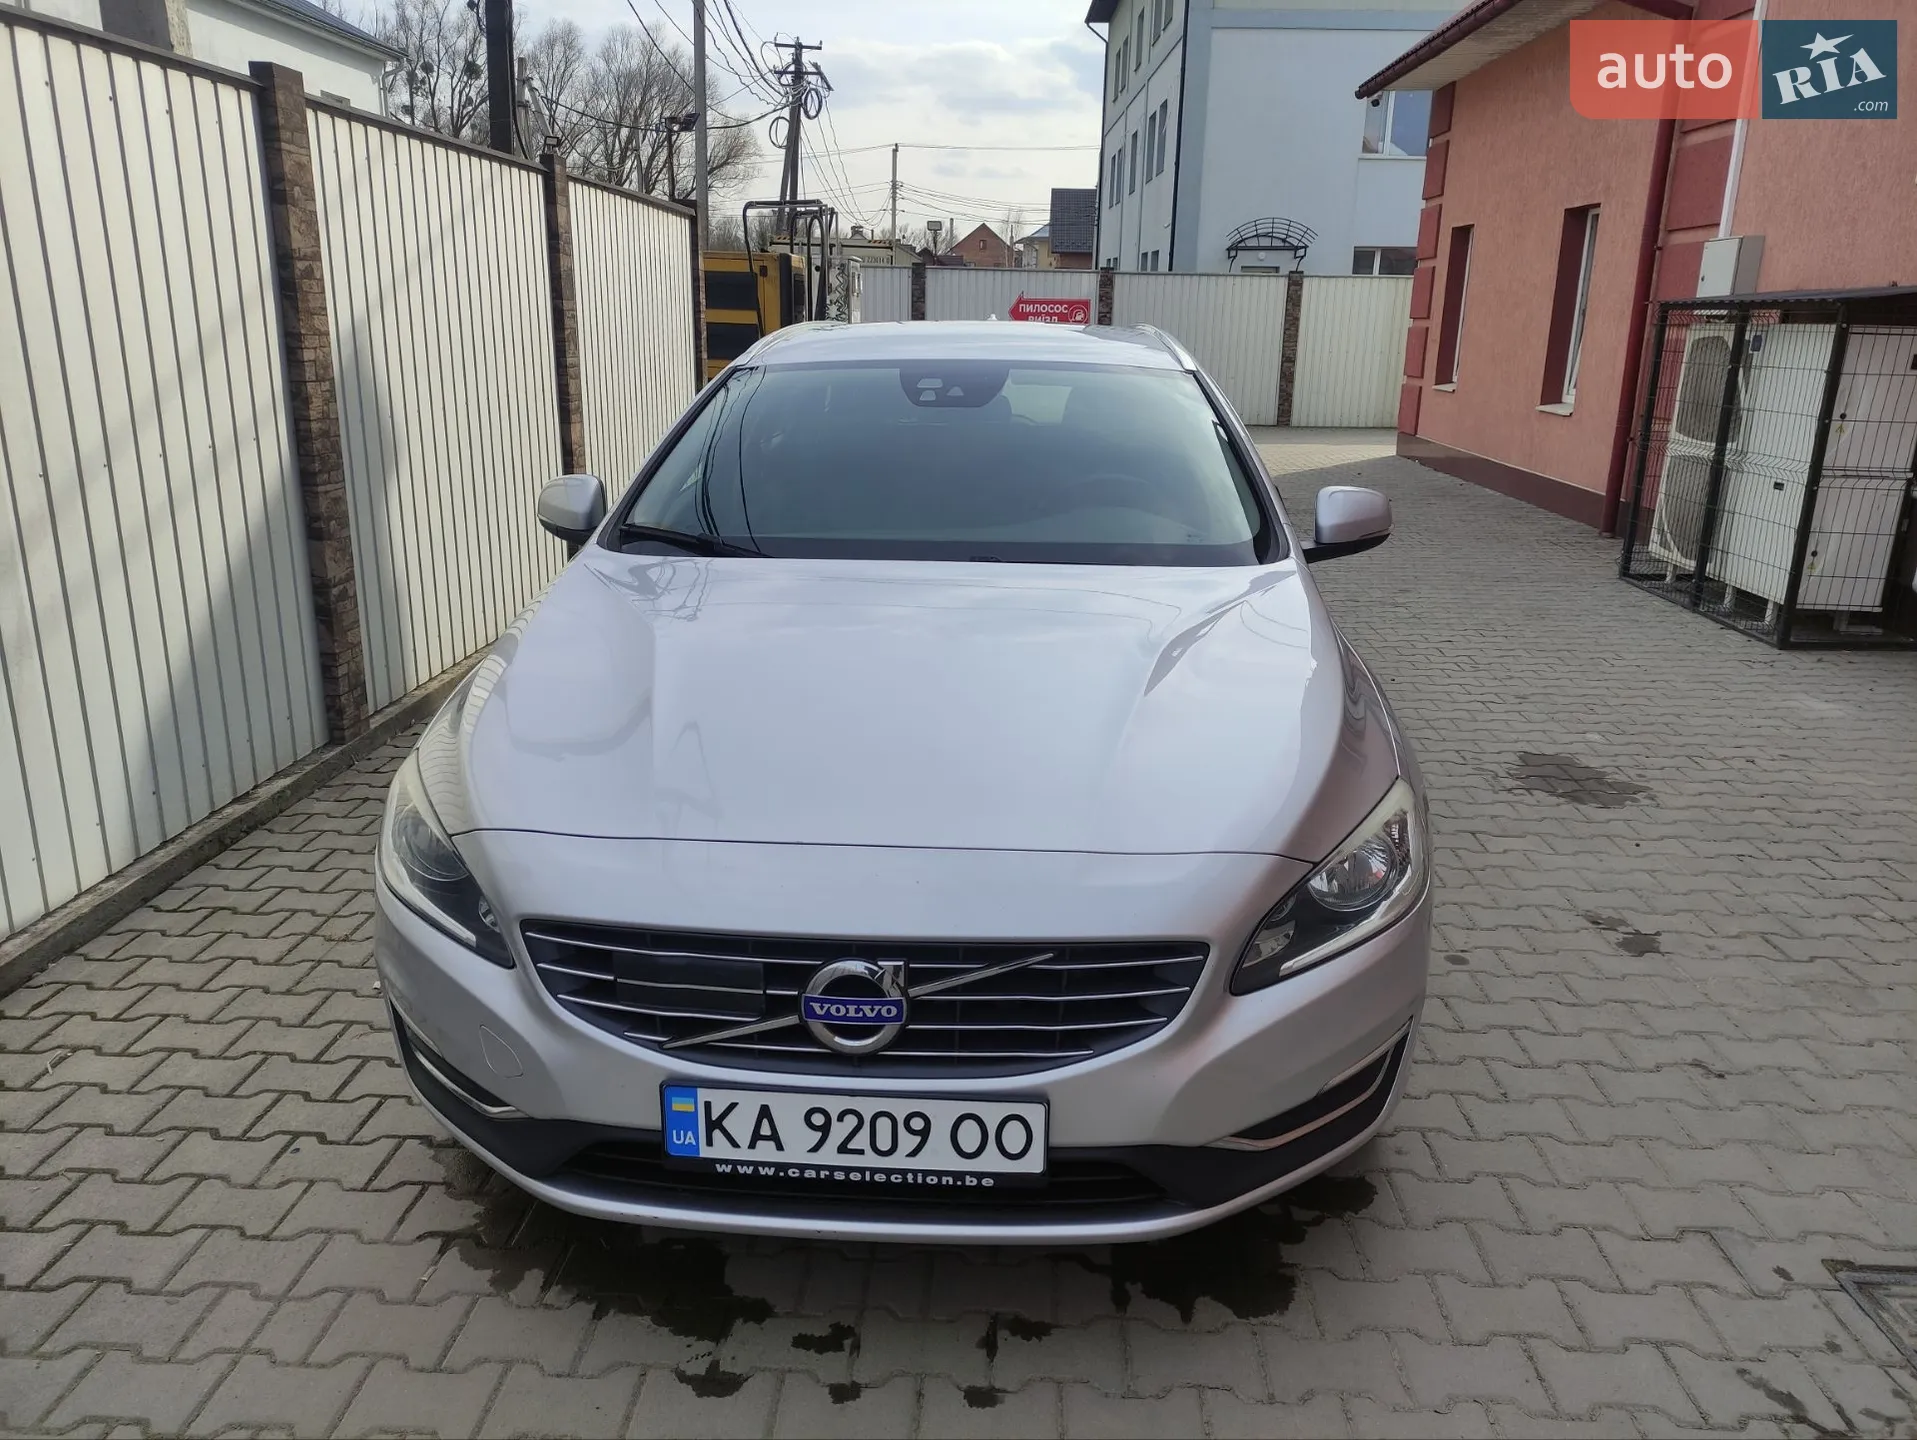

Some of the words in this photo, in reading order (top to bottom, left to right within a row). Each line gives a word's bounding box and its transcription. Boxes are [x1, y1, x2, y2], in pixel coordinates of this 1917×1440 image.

[1019, 303, 1069, 313] ПИЛОСОС
[809, 1002, 898, 1018] VOLVO
[672, 1130, 697, 1146] UA
[704, 1101, 785, 1152] KA
[803, 1106, 932, 1158] 9209
[950, 1112, 1034, 1161] OO
[715, 1162, 995, 1188] www.carselection.be
